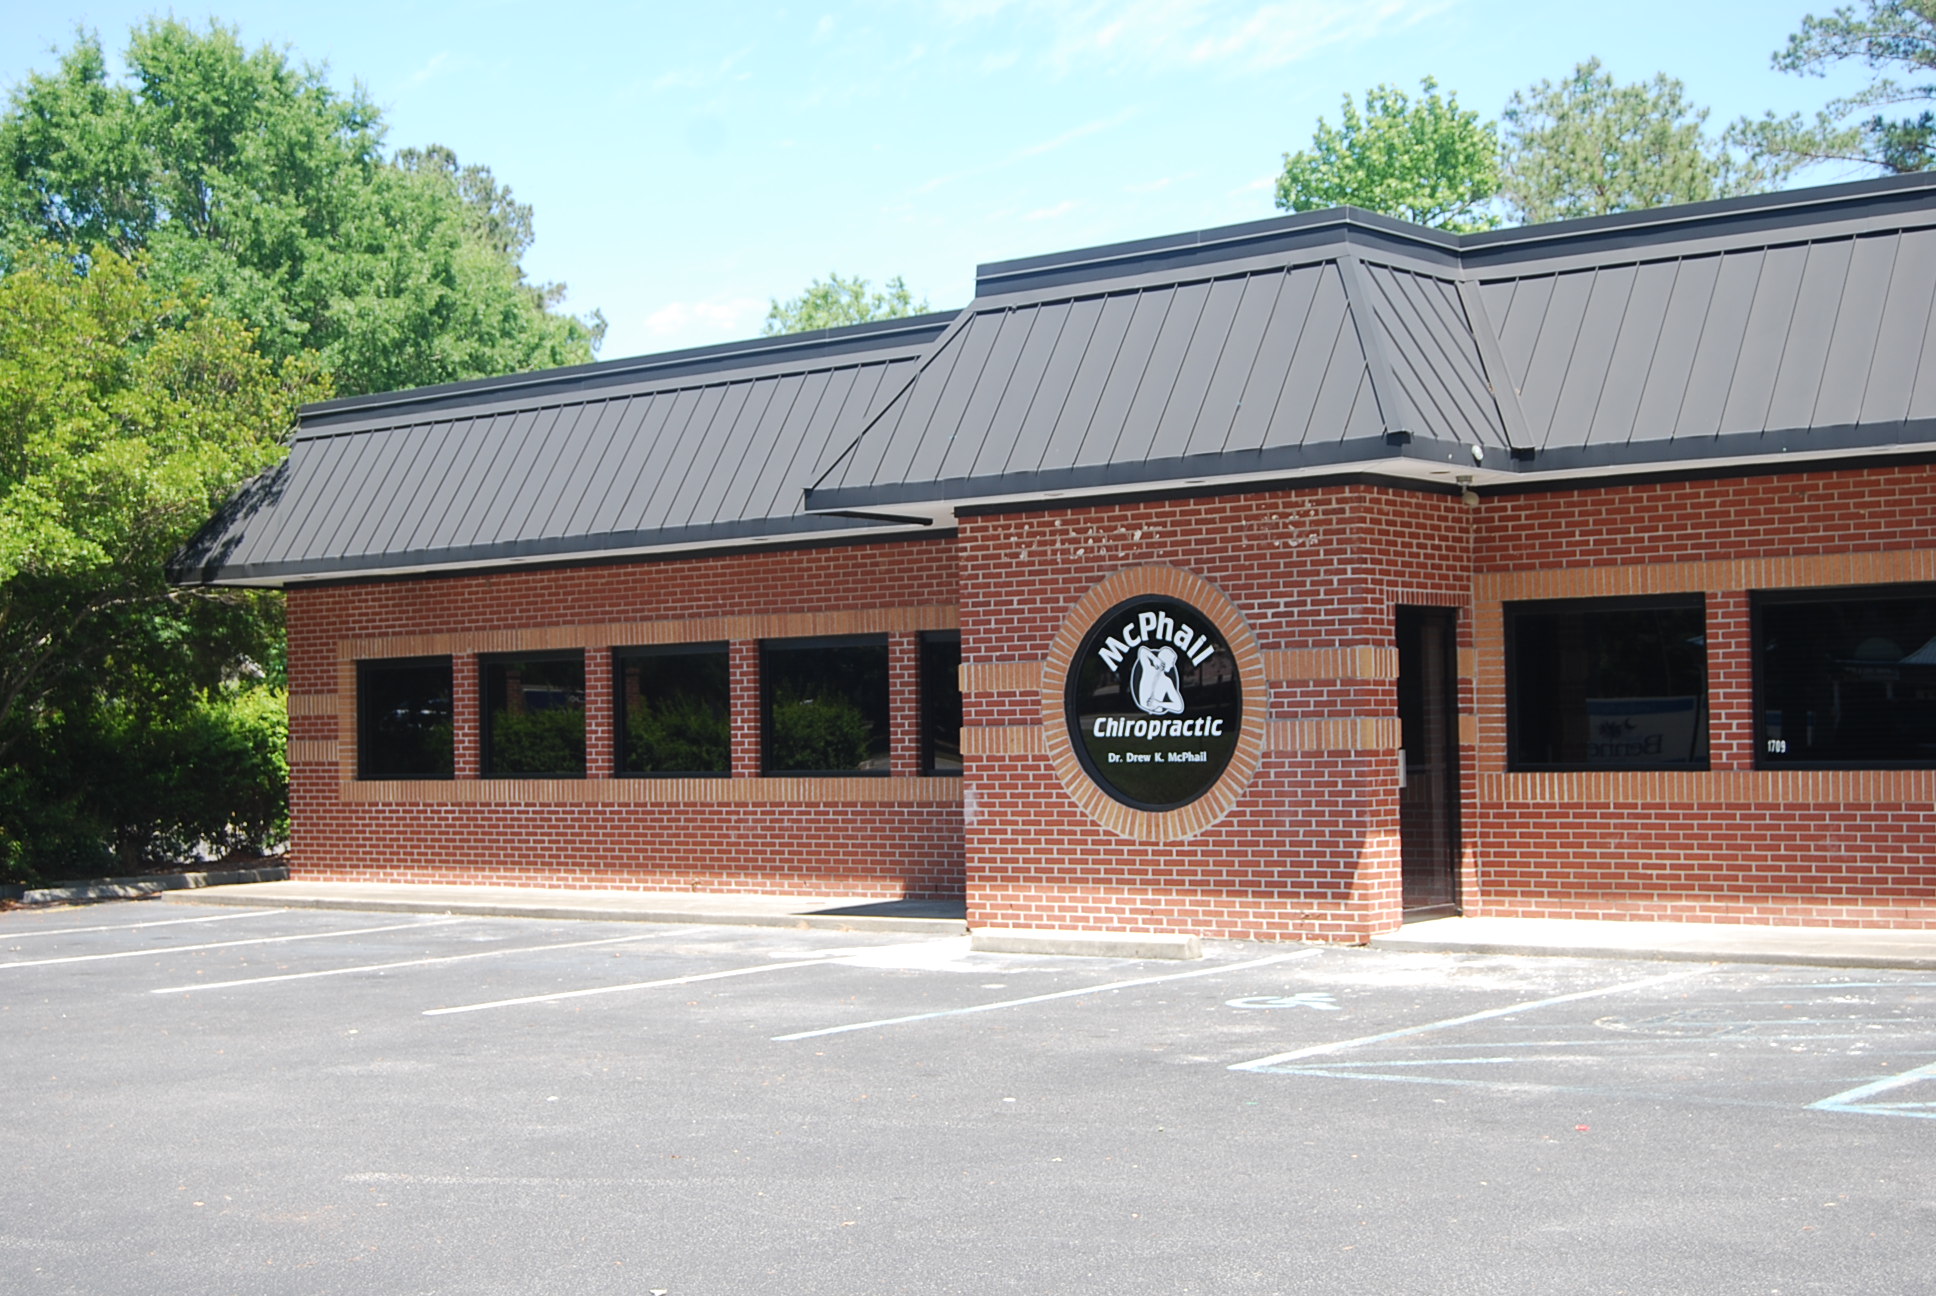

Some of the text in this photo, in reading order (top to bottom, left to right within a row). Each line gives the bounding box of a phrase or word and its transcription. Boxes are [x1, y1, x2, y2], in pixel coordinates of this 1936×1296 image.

[1098, 611, 1215, 672] McPhail
[1093, 717, 1223, 740] Chiropractic
[1767, 740, 1786, 753] 1709
[1108, 751, 1207, 763] Dr. Drew K. McPhail
